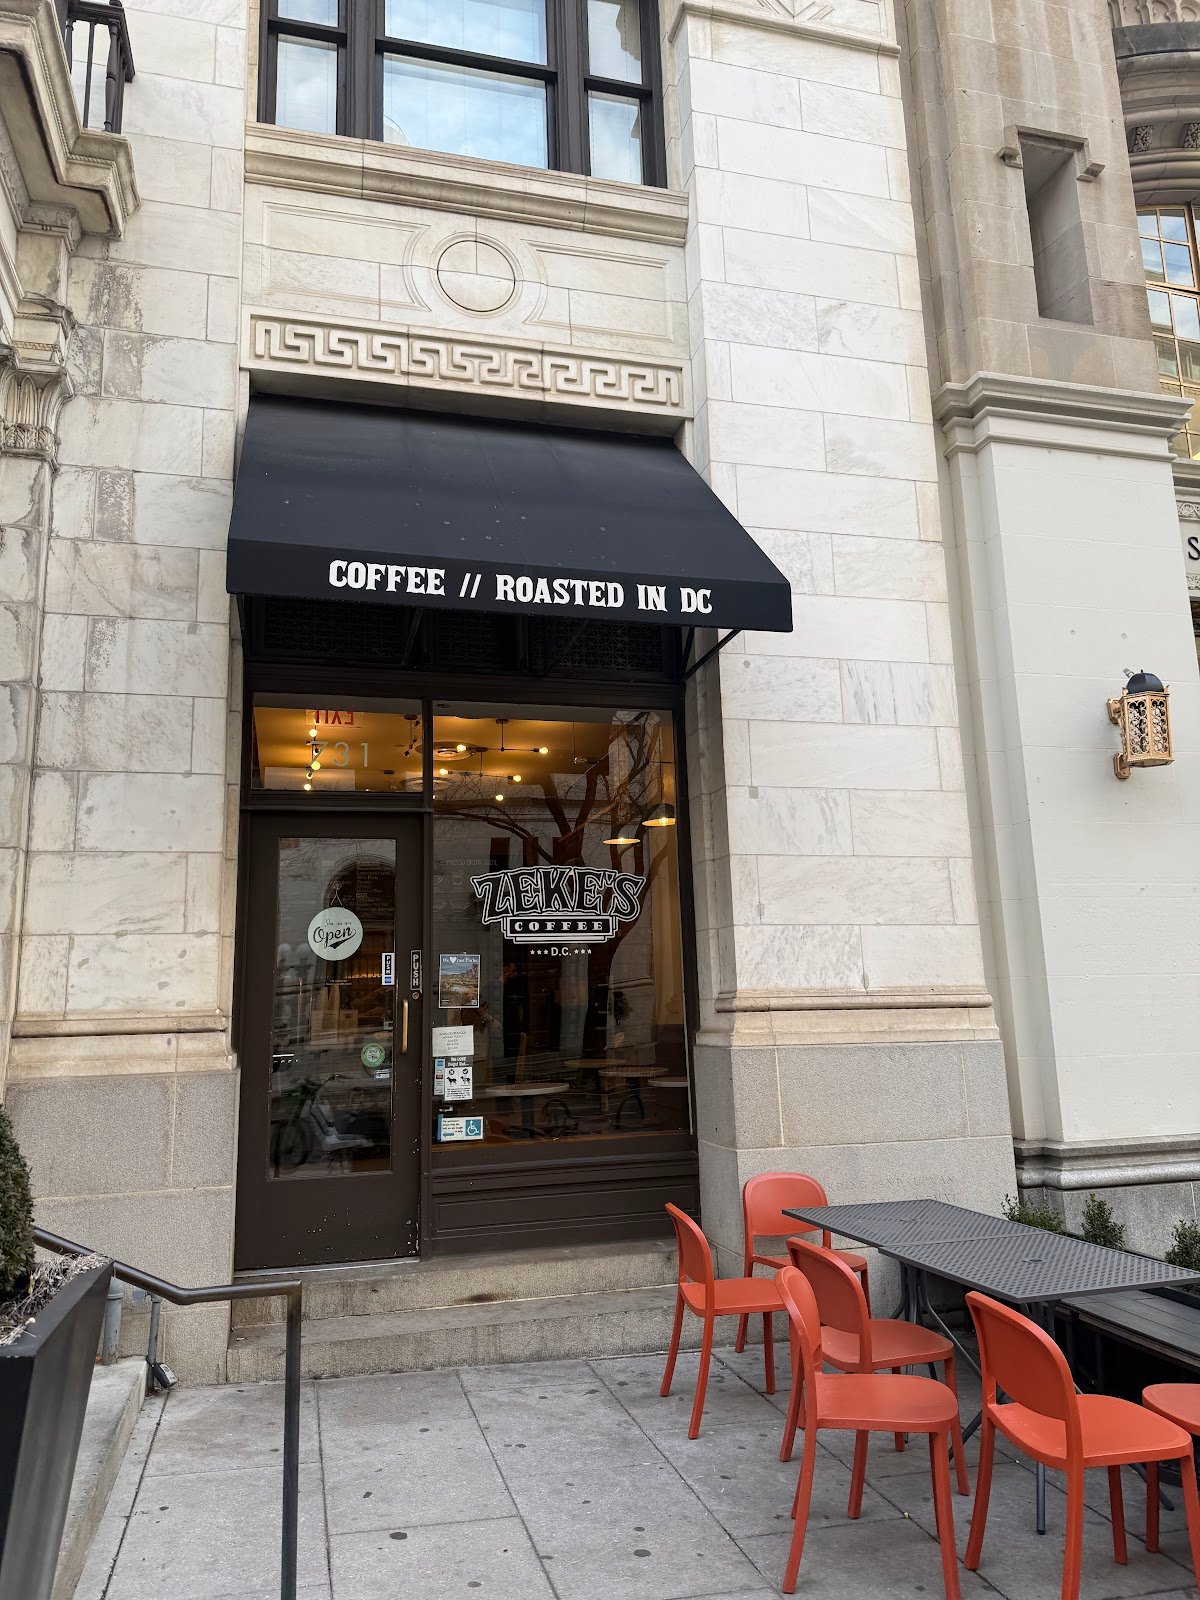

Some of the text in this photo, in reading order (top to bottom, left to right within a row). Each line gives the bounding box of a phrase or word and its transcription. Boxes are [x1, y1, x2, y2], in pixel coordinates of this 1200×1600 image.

[328, 559, 446, 596] COFFEE
[495, 573, 625, 608] ROASTED
[636, 583, 668, 613] IN
[680, 587, 712, 614] DC
[306, 741, 369, 769] 731
[470, 865, 646, 924] ZEKE'S
[313, 926, 354, 949] Open
[514, 921, 603, 932] COFFEE
[551, 947, 572, 956] D.C.
